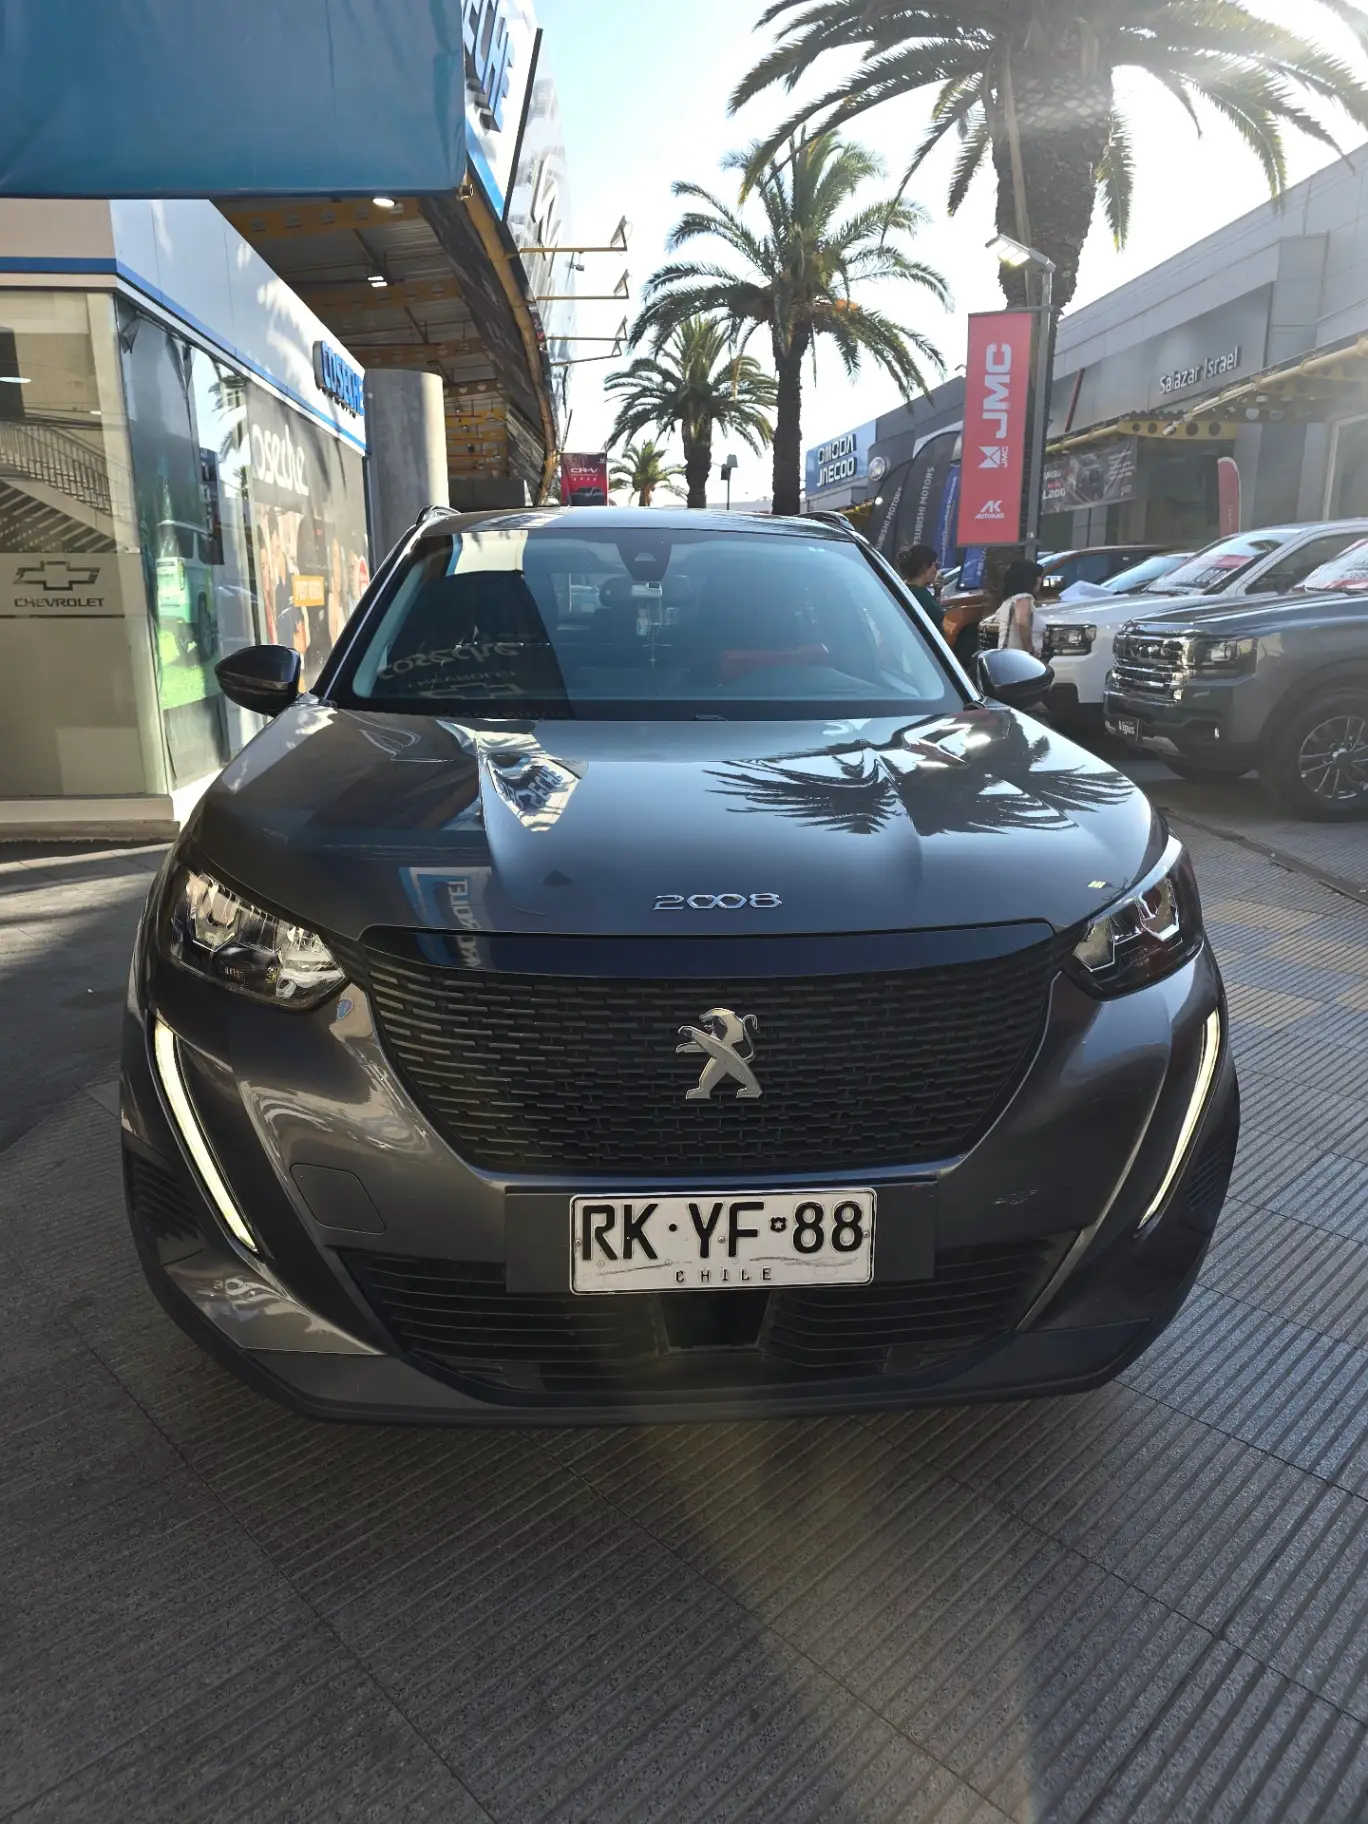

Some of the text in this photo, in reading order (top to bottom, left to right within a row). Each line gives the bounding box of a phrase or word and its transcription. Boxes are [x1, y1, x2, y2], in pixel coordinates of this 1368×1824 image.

[1159, 344, 1240, 395] Salazar Israel
[982, 342, 1012, 439] JMC
[920, 466, 935, 505] MOTORS
[14, 597, 105, 608] CHEVROLET
[652, 893, 782, 910] 2008
[674, 1266, 772, 1283] CHILE
